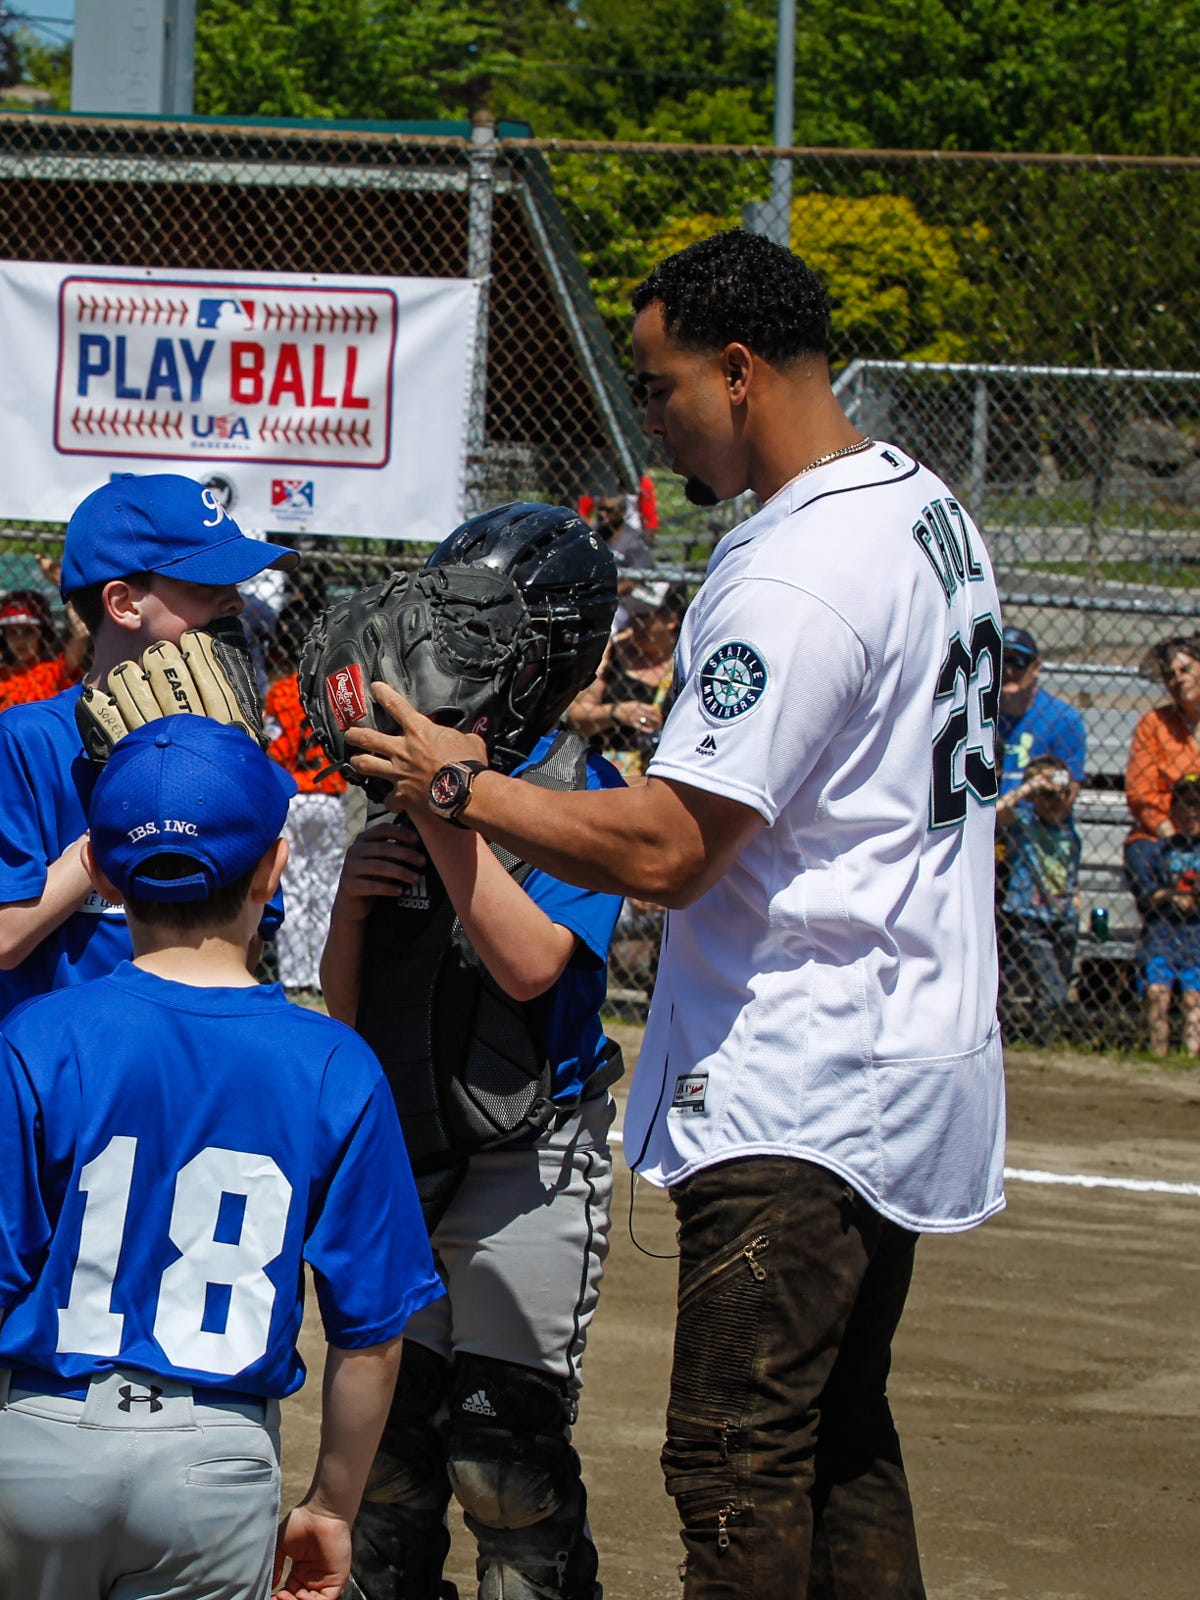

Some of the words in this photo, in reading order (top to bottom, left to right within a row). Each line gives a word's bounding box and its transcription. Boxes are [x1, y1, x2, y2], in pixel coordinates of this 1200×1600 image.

[77, 333, 216, 403] PLAY
[229, 341, 371, 410] BALL
[191, 413, 250, 440] USA
[709, 646, 764, 680] SEATTLE
[335, 672, 356, 718] Rawlings
[703, 684, 756, 718] MARINERS
[928, 612, 1003, 831] 23
[126, 821, 161, 844] IBS,
[163, 819, 199, 837] INC.
[55, 1135, 294, 1377] 18
[462, 1400, 497, 1417] adidas
